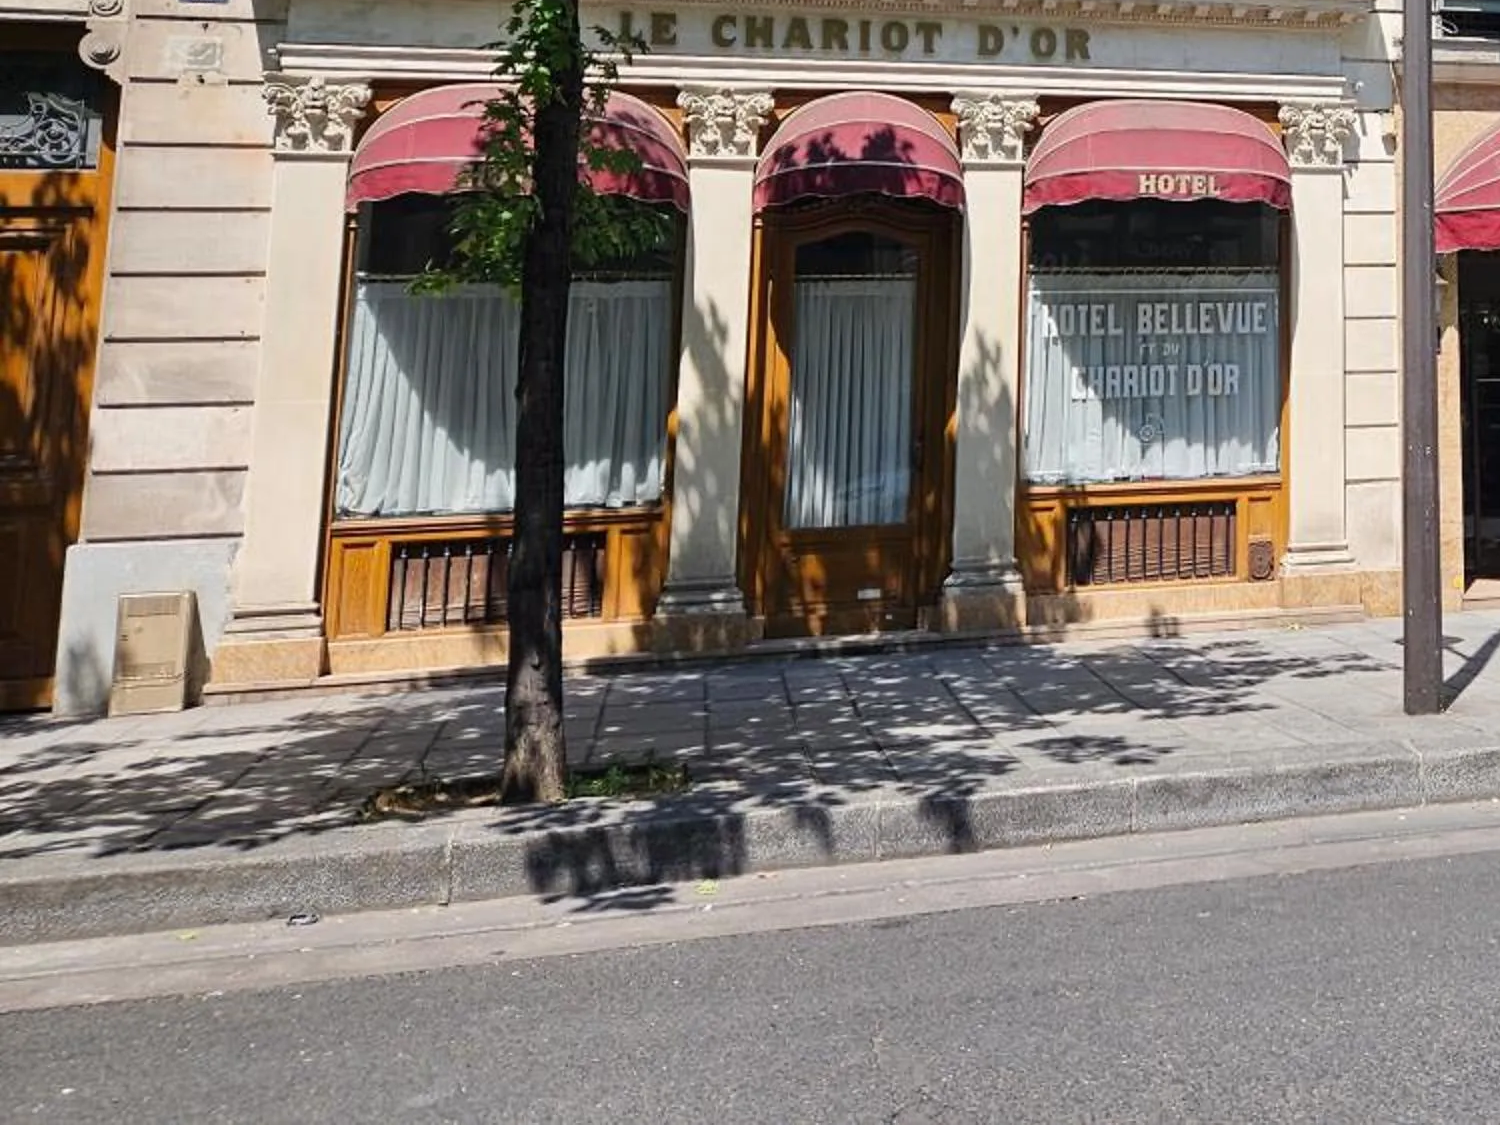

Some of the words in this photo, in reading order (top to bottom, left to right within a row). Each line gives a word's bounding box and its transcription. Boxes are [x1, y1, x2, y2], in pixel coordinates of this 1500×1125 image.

[618, 10, 678, 46] LE
[711, 12, 943, 55] CHARIOT
[977, 22, 1092, 60] D'OR
[1138, 174, 1221, 196] HOTEL
[1041, 302, 1124, 338] HOTEL
[1137, 301, 1268, 335] BELLEVUE
[1071, 363, 1179, 400] CHARIOT
[1187, 353, 1240, 397] D'OR
